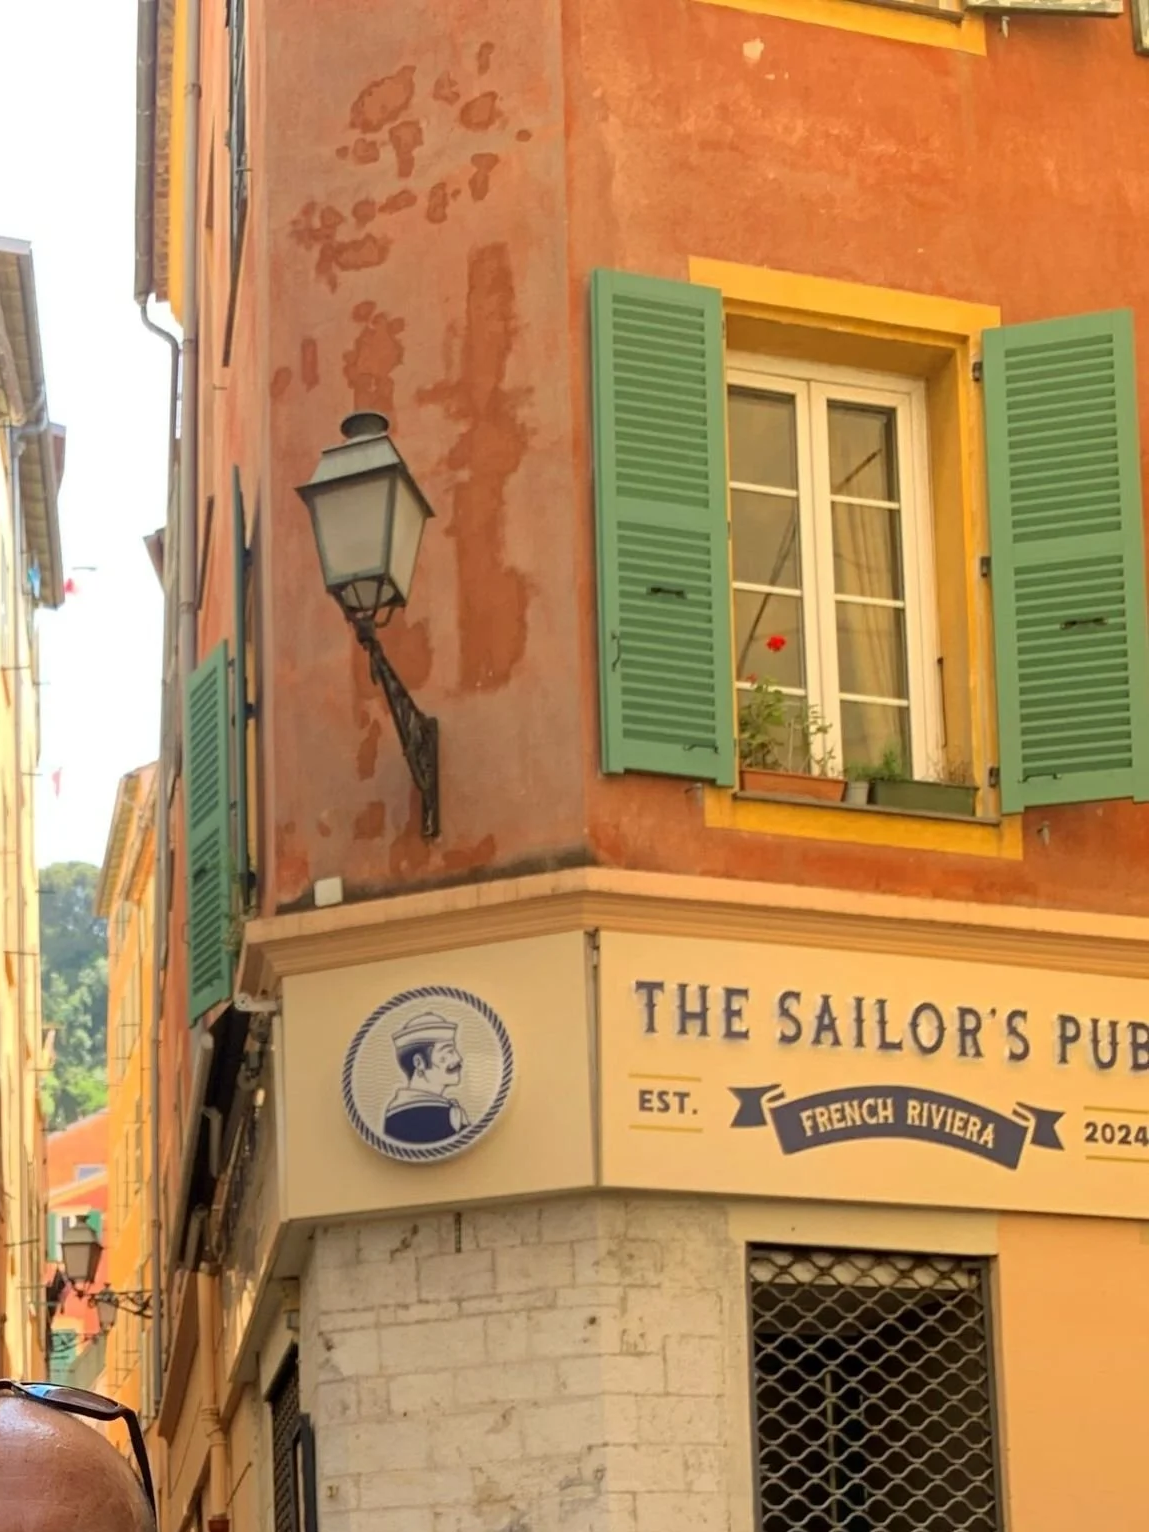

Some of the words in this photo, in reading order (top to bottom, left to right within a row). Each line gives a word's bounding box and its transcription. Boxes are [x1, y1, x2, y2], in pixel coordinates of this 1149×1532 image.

[634, 979, 750, 1041] THE
[777, 989, 1032, 1063] SAILOR'S
[1056, 1013, 1149, 1073] PUB
[637, 1088, 699, 1116] EST.
[800, 1097, 894, 1137] FRENCH
[906, 1098, 997, 1149] RIVIERA
[1083, 1121, 1149, 1147] 2024
